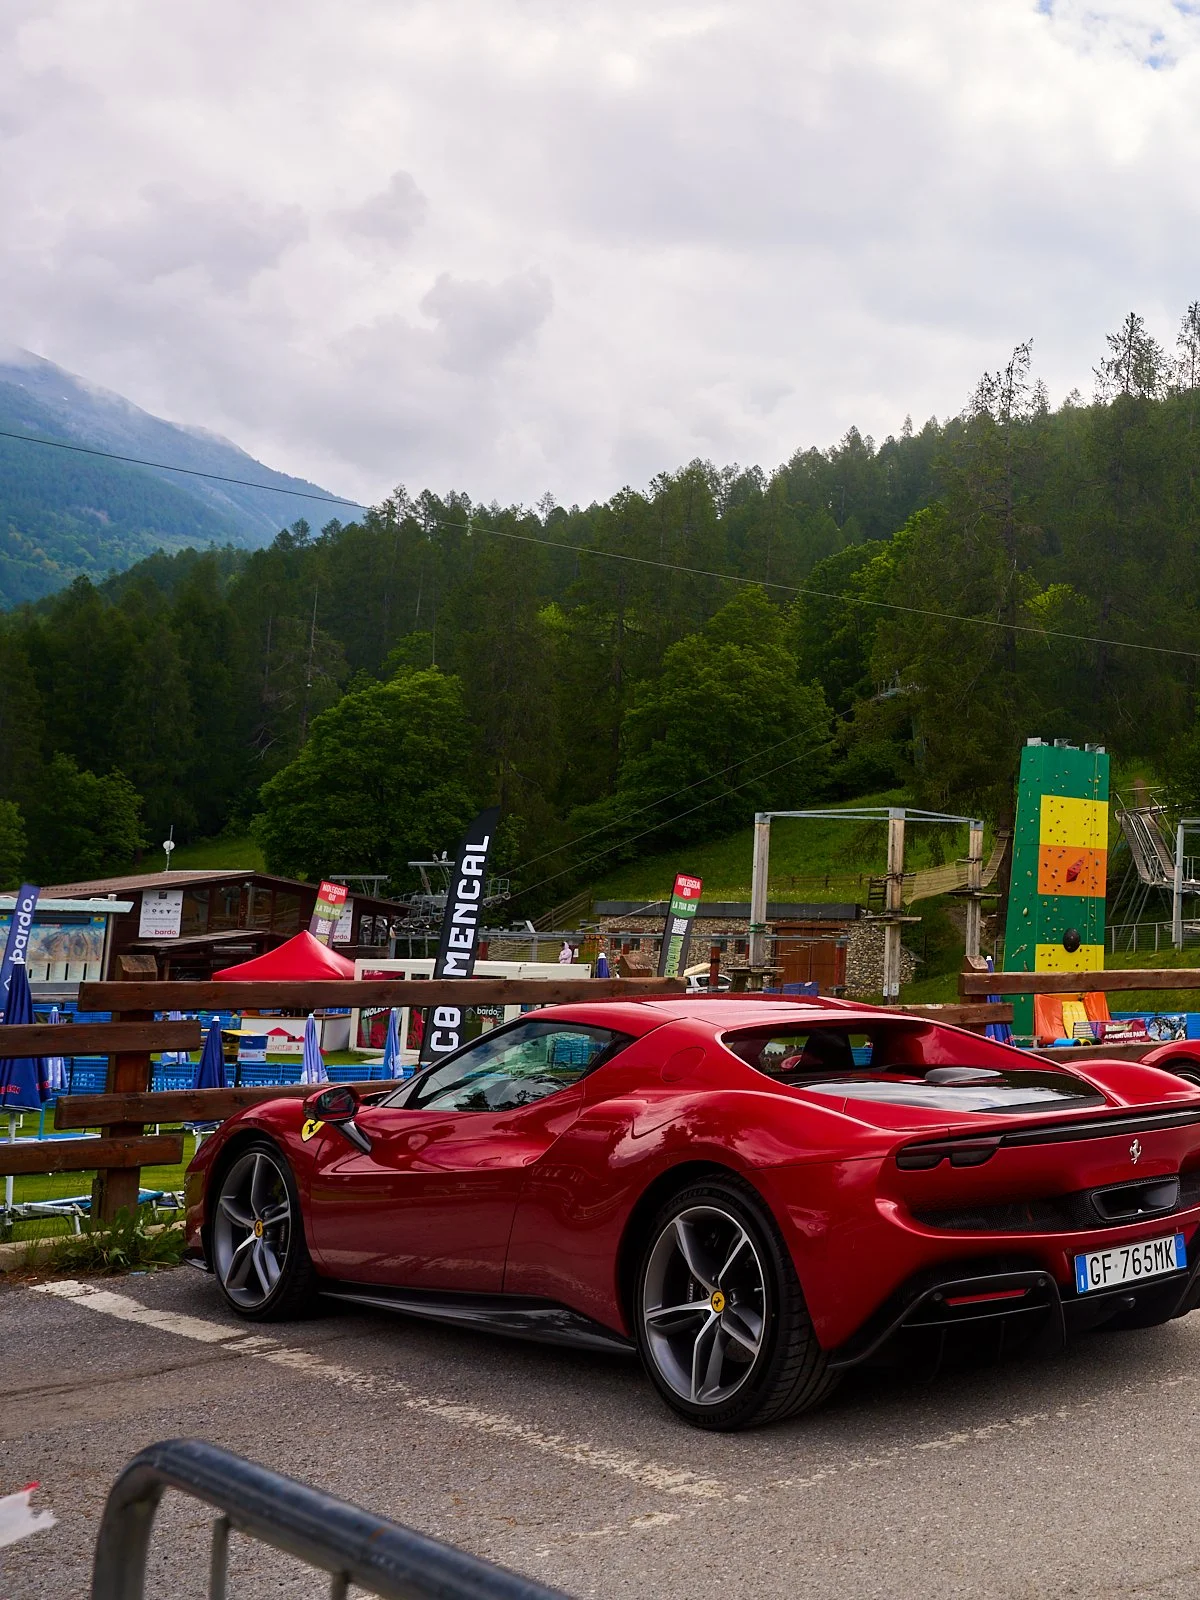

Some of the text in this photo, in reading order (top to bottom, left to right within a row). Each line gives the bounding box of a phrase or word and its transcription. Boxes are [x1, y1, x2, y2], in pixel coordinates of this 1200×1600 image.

[322, 884, 346, 896] NOLEGGIA
[430, 835, 490, 1052] COMENCAL
[1089, 1239, 1175, 1286] GF 765MK
